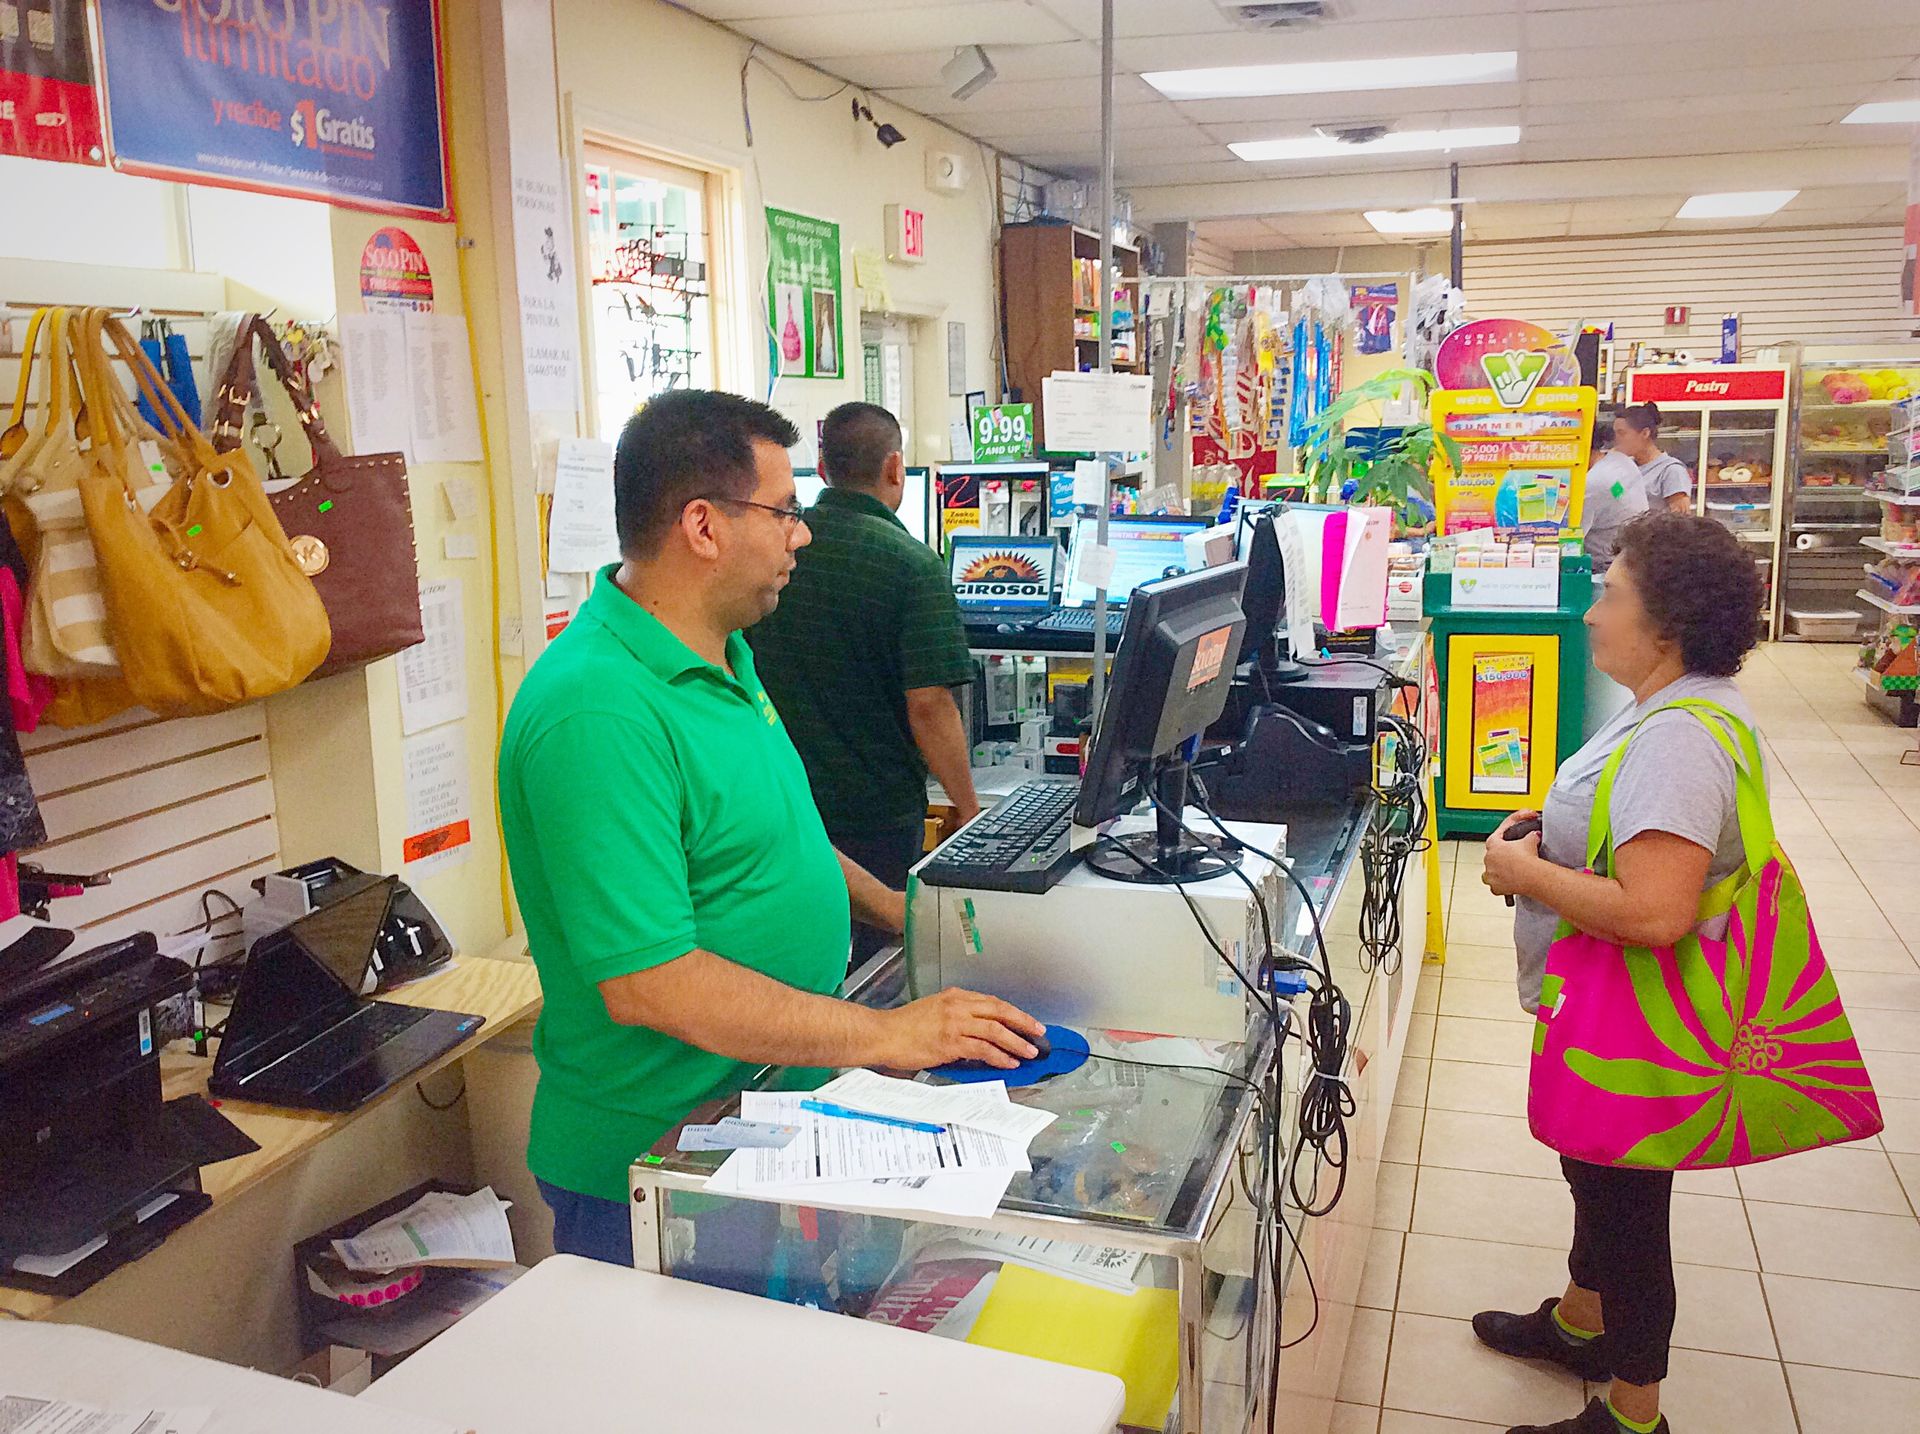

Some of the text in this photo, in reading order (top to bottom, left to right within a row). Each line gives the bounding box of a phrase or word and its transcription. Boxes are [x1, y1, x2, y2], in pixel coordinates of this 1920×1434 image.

[1685, 380, 1730, 395] Pastry
[1454, 420, 1572, 431] SUMMER JAM
[985, 445, 1005, 456] AND
[954, 584, 1049, 596] GIROSOL
